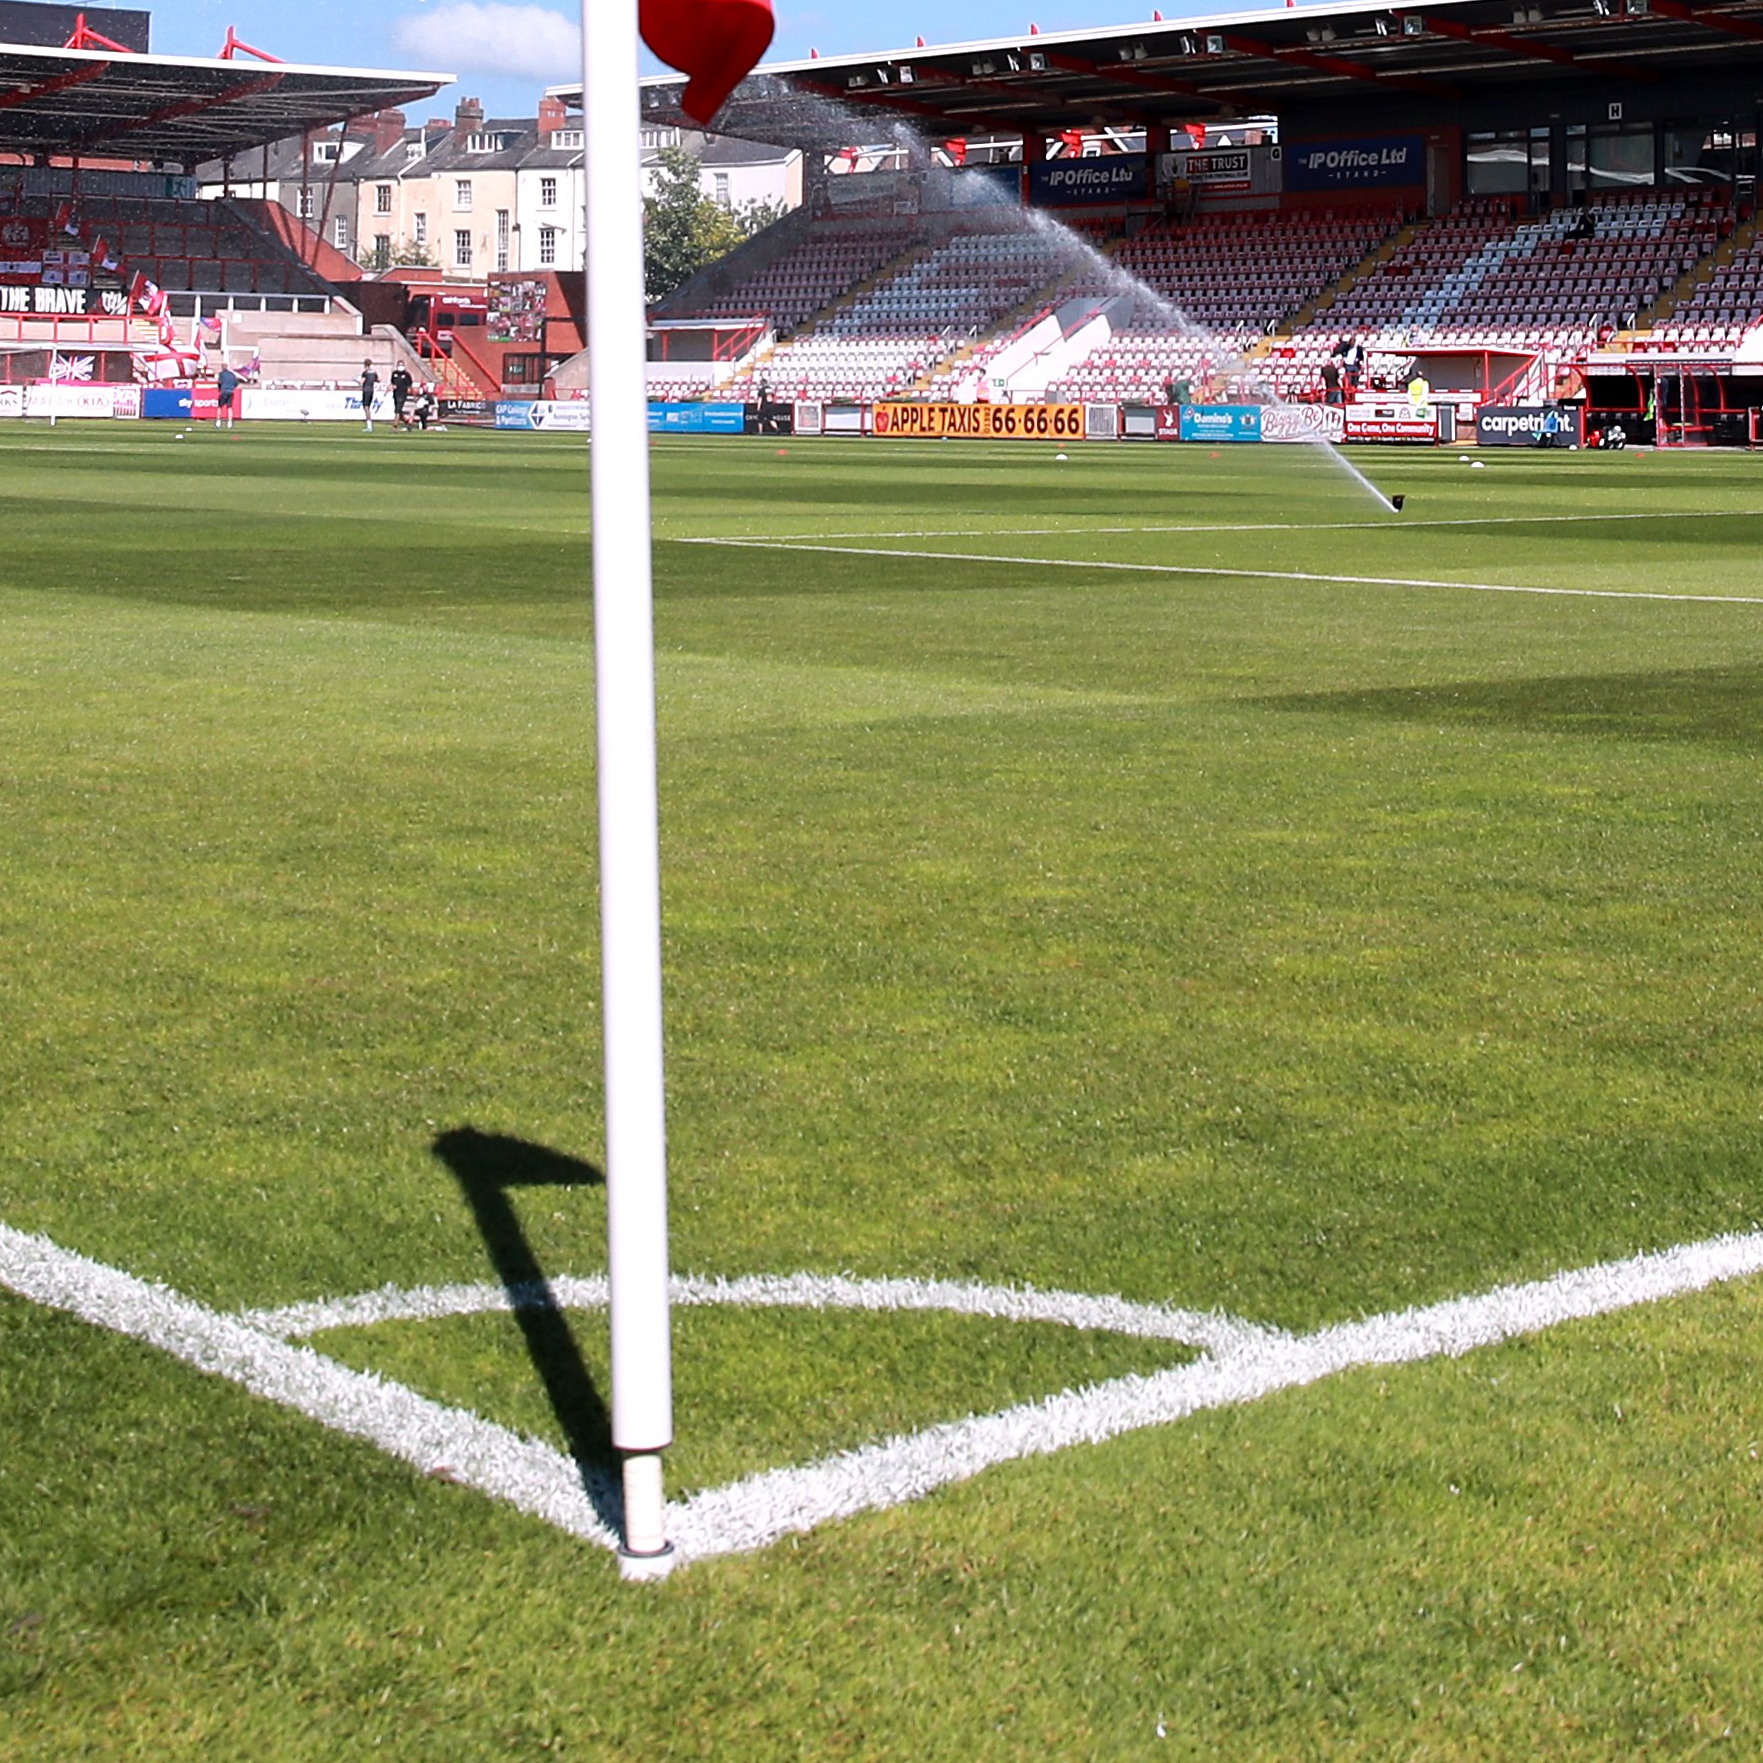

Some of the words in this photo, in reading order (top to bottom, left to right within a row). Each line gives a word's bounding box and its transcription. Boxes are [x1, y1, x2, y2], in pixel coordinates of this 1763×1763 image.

[1611, 104, 1620, 118] H
[1381, 147, 1407, 164] Ltd
[1188, 158, 1210, 172] THE
[1211, 156, 1246, 170] TRUST
[0, 286, 30, 312] THE
[35, 287, 87, 314] BRAVE
[890, 407, 935, 432] APPLE
[938, 406, 981, 433] TAXIS
[1194, 412, 1233, 424] Domino's
[1481, 409, 1575, 437] carpetriht.
[1347, 422, 1361, 433] One
[1382, 422, 1395, 433] One
[1396, 422, 1435, 437] Community
